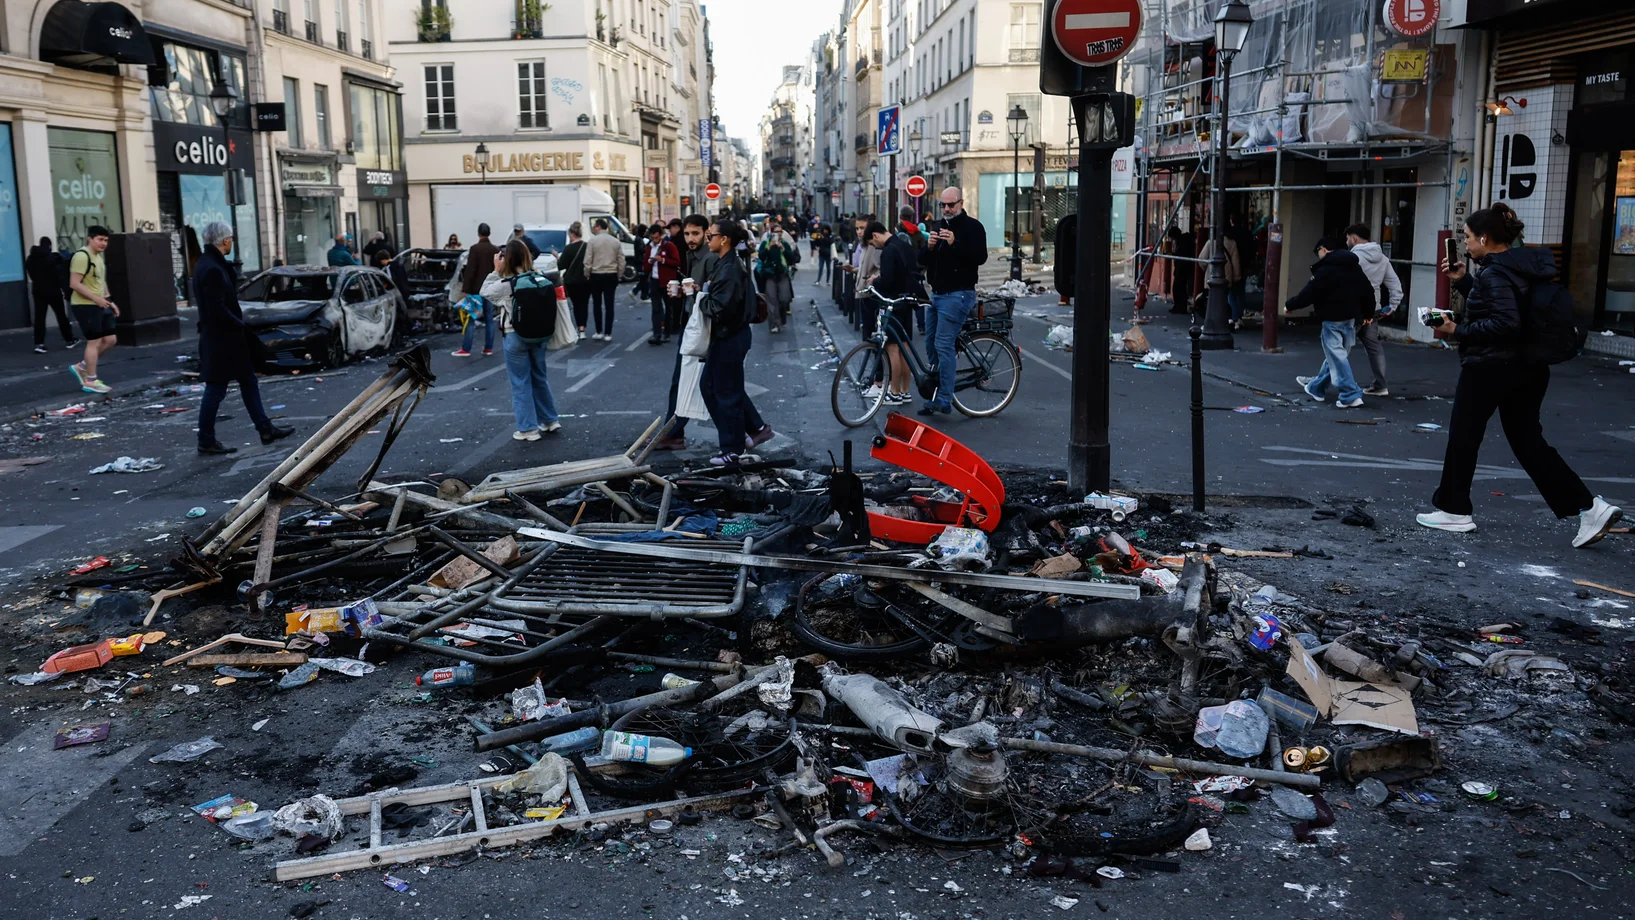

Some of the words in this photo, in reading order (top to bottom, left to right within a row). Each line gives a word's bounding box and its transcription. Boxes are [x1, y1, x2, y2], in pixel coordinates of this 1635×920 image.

[1586, 75, 1597, 86] MY
[1597, 72, 1619, 83] TASTE
[176, 136, 227, 165] celio
[463, 152, 584, 173] BOULANGERIE
[1115, 159, 1127, 172] PIZZA
[59, 174, 105, 199] celio
[65, 205, 74, 214] be
